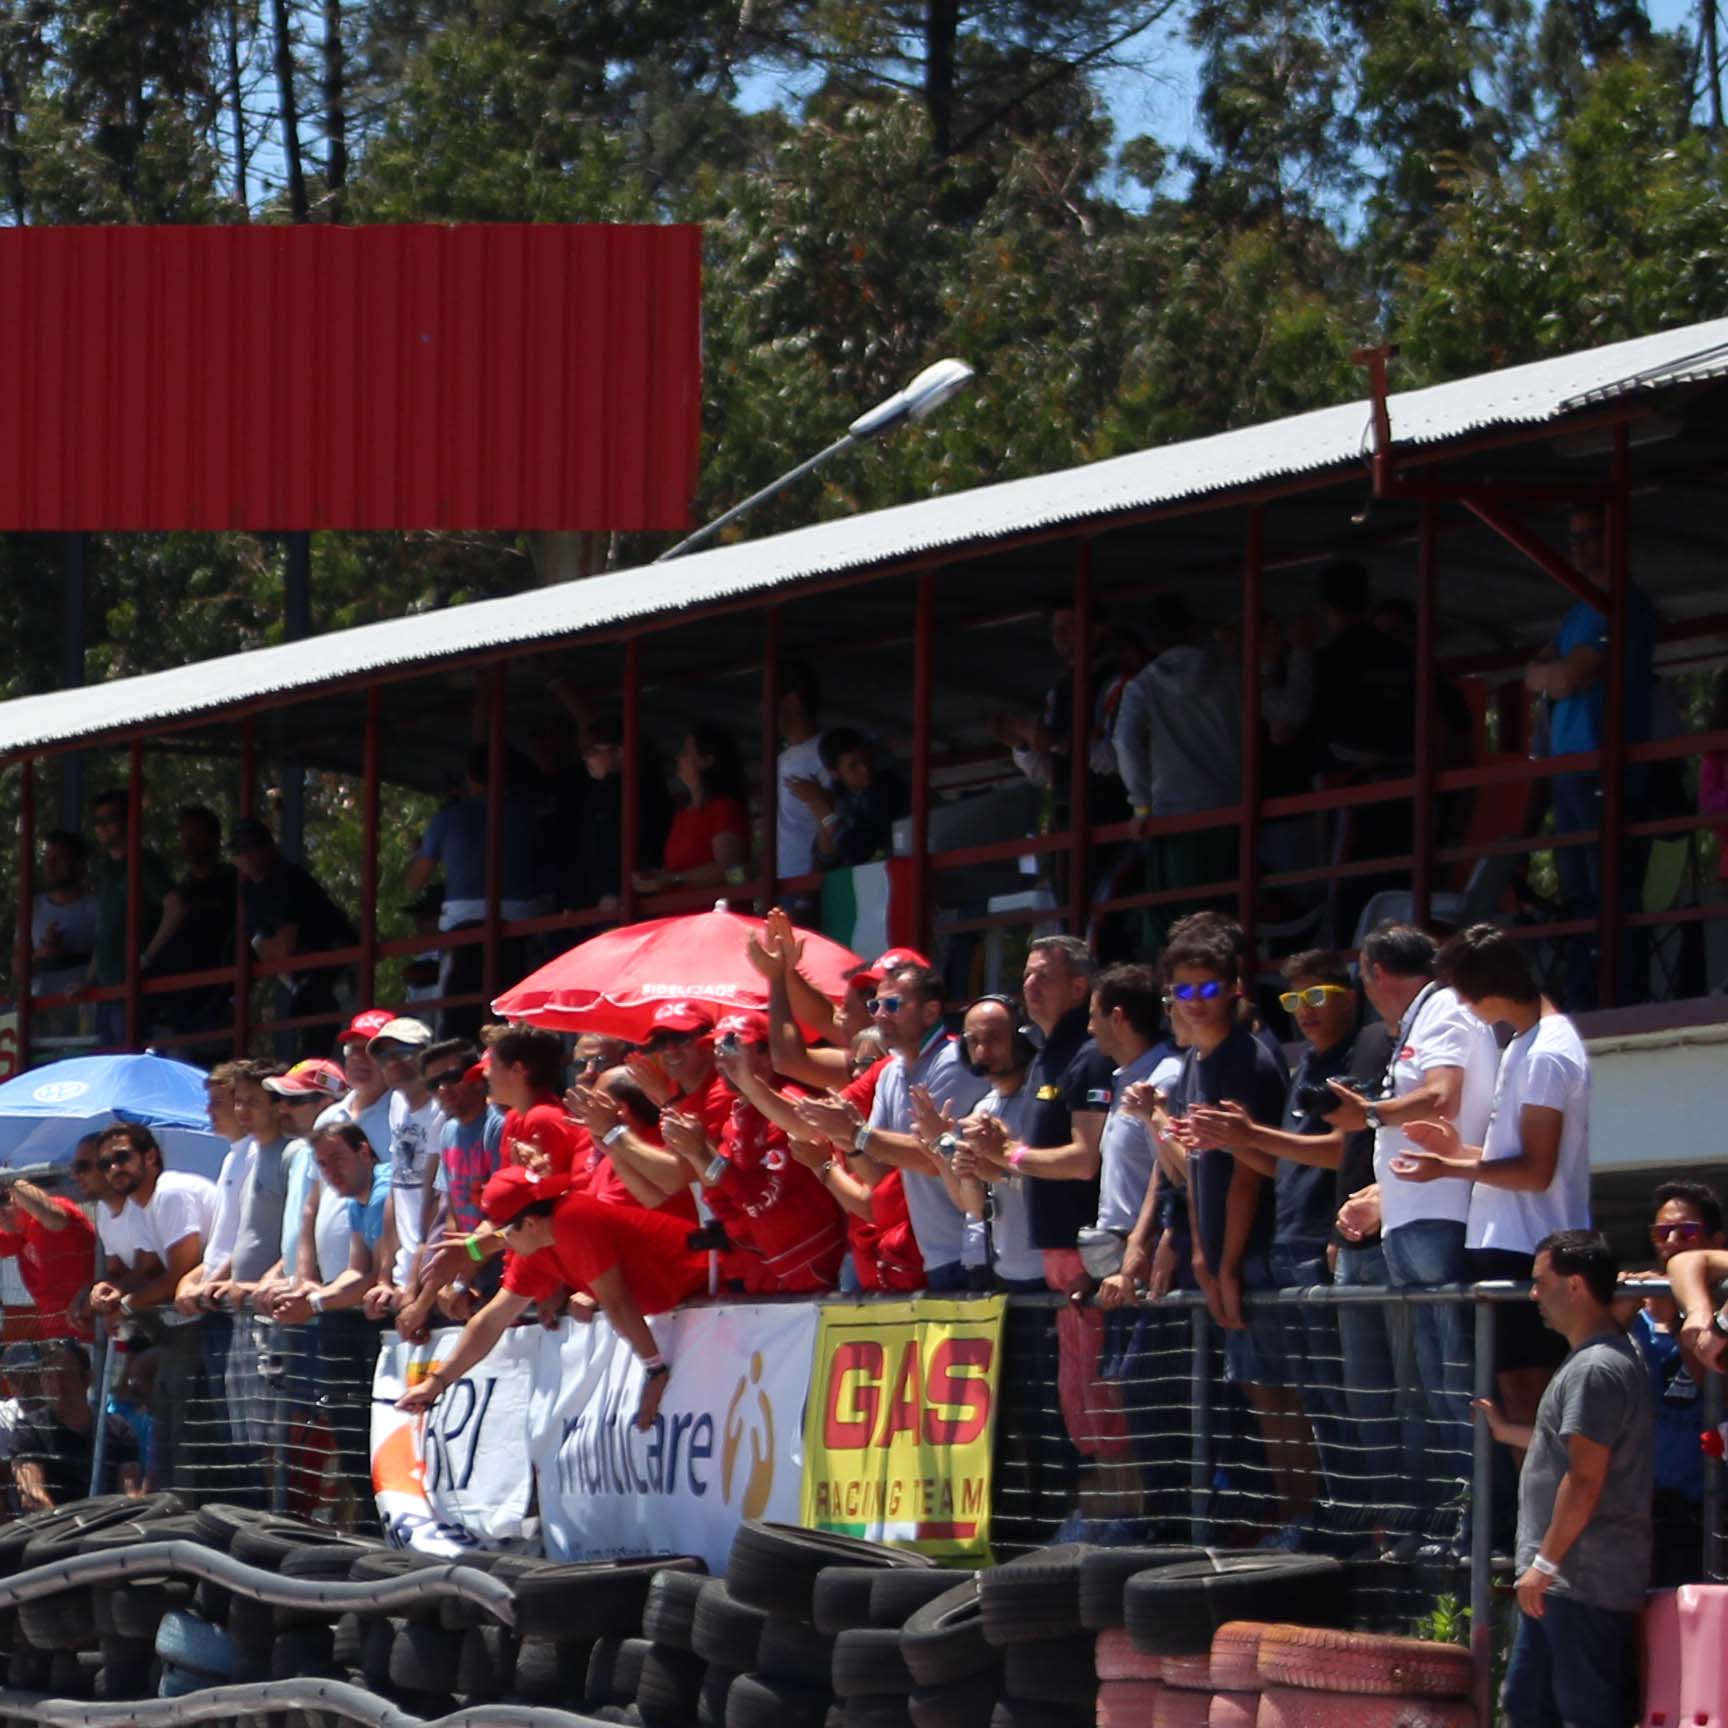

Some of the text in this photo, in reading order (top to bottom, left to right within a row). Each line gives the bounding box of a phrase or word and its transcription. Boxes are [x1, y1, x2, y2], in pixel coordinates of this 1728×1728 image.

[641, 983, 737, 999] FIDELIDADE
[823, 1337, 994, 1450] GAS
[815, 1477, 984, 1517] RACING TEAM
